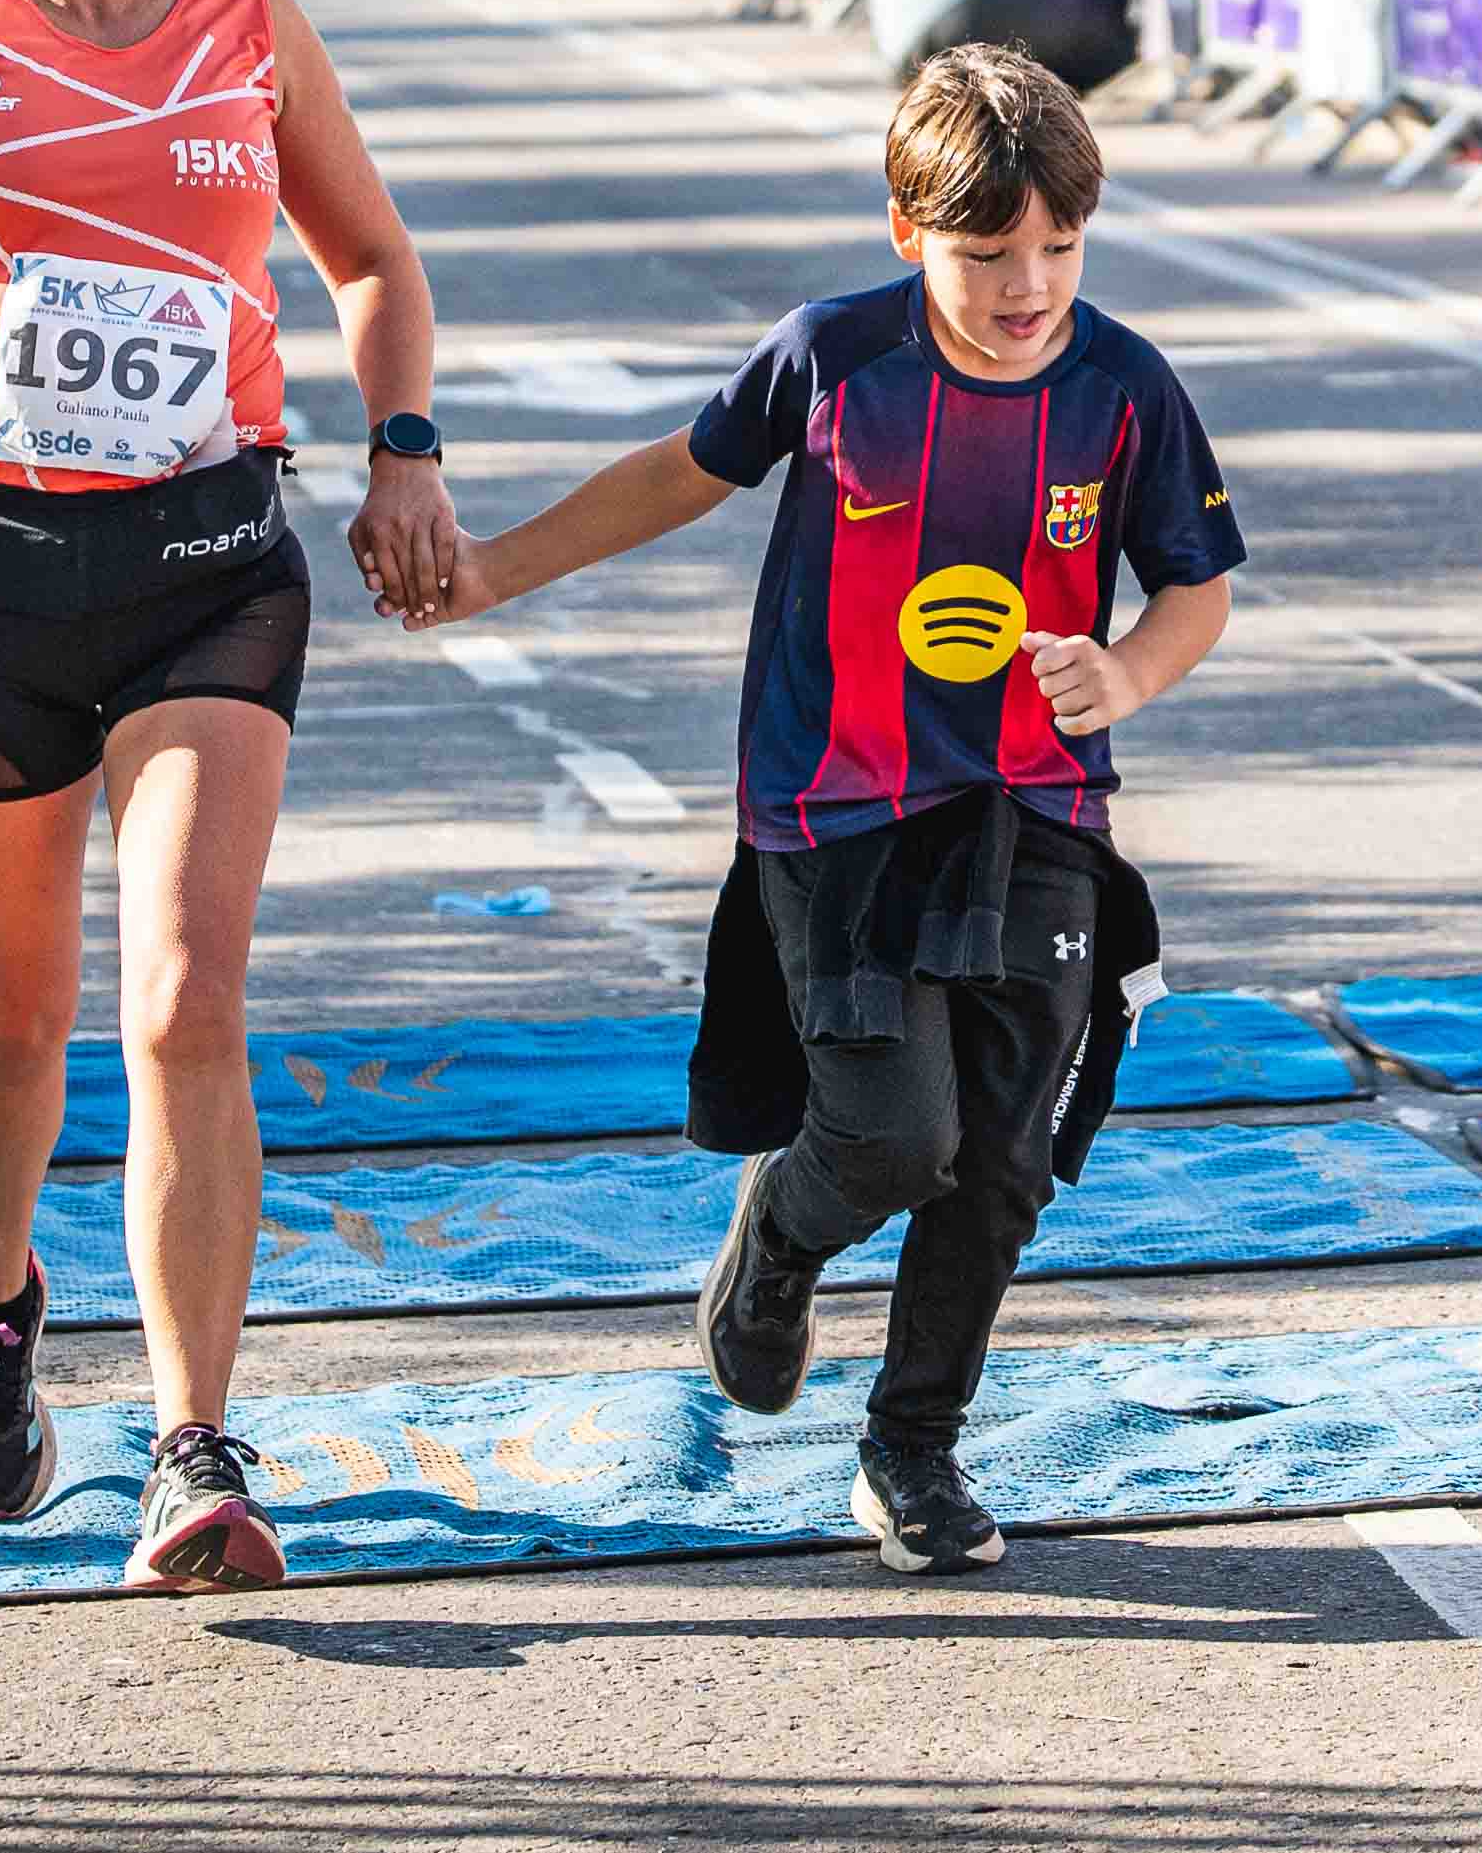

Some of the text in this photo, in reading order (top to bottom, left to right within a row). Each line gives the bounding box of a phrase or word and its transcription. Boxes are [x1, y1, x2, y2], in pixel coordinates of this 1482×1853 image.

[169, 139, 247, 176] 15K
[175, 177, 247, 189] PUERTO
[39, 276, 89, 311] 5K
[163, 303, 195, 324] 15K
[4, 321, 217, 407] 1967
[55, 400, 150, 424] Galiano Paula
[21, 429, 92, 456] osde
